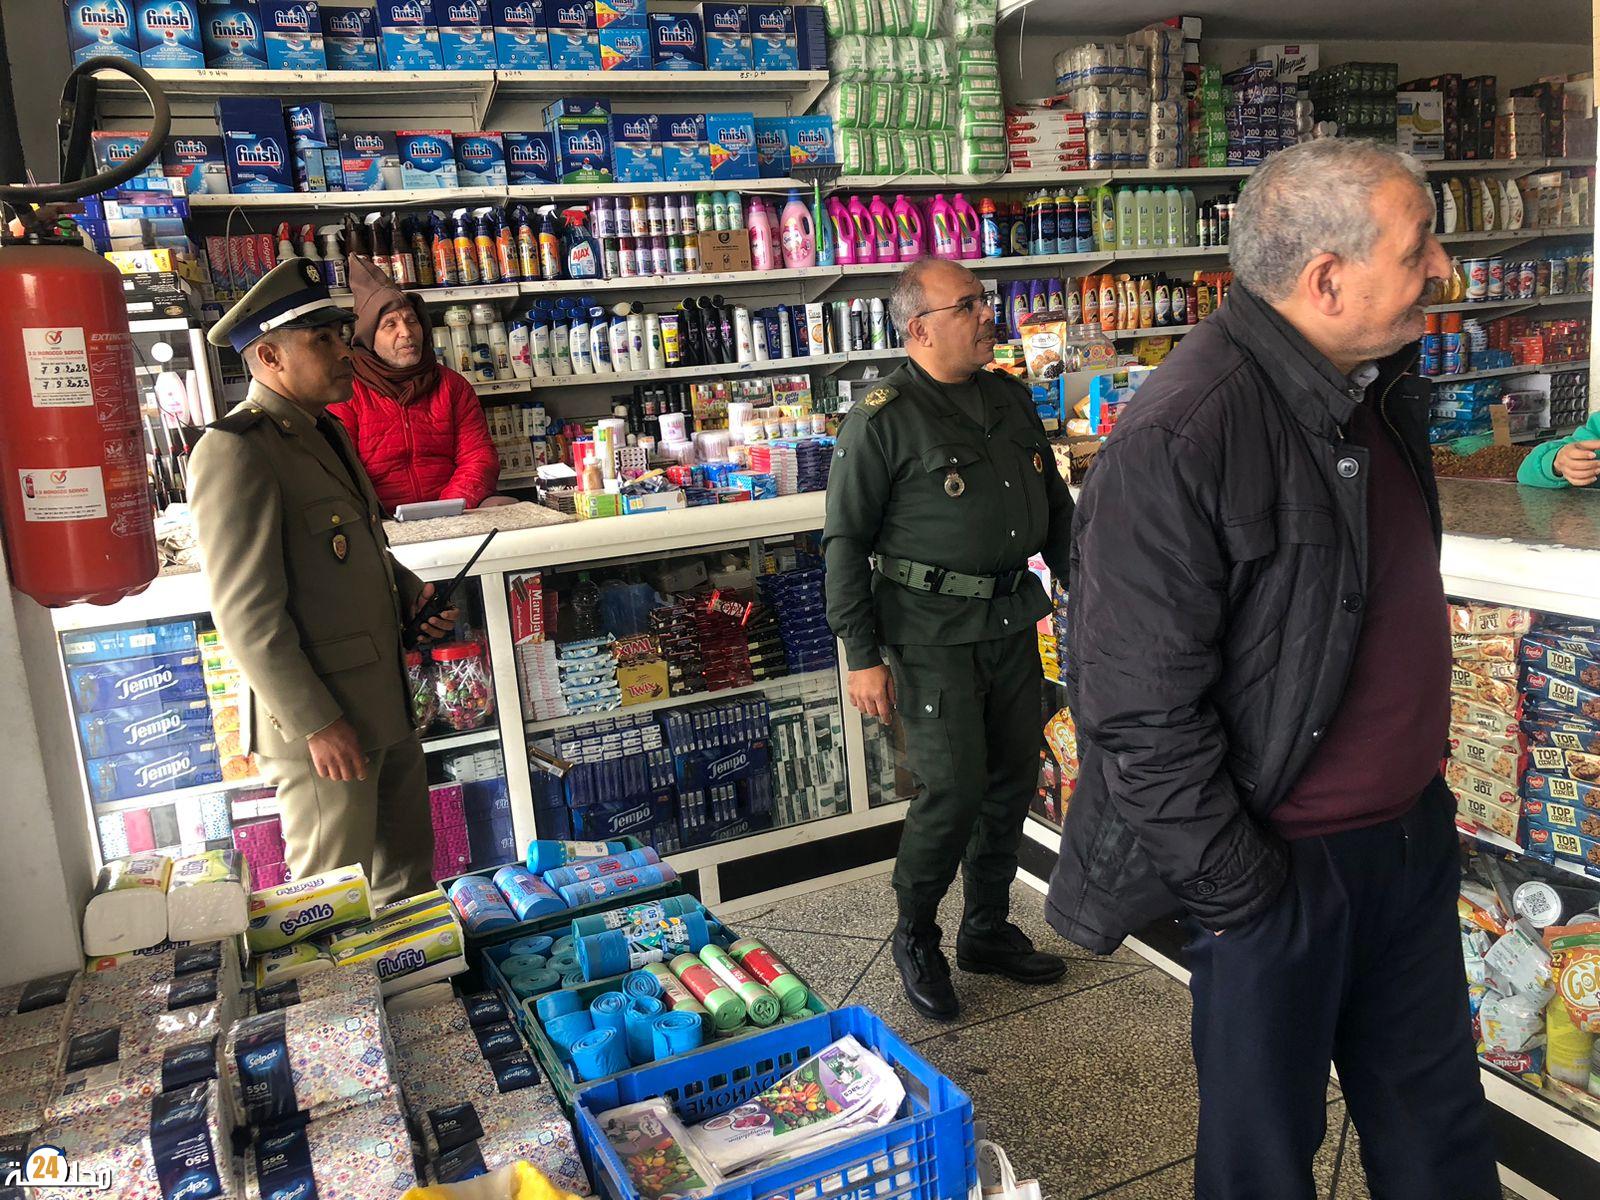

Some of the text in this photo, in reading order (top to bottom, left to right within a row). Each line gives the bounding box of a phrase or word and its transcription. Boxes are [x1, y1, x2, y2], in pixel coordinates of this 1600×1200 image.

[81, 5, 125, 24] finish
[145, 9, 189, 27] finish
[275, 10, 306, 25] finish
[392, 6, 423, 19] finish
[449, 6, 478, 20] finish
[505, 7, 533, 21] finish
[558, 9, 584, 23] finish
[331, 16, 360, 30] finish
[714, 14, 738, 27] finish
[760, 14, 784, 28] finish
[212, 20, 253, 37] finish
[659, 27, 693, 44] finish
[616, 37, 636, 48] finish
[1244, 107, 1256, 115] 200
[1264, 107, 1276, 115] 200
[290, 113, 313, 129] finish
[624, 123, 649, 136] finish
[672, 123, 696, 136] finish
[719, 129, 746, 142] finish
[799, 130, 824, 142] finish
[1246, 128, 1260, 136] 200
[1264, 129, 1277, 137] 200
[1282, 128, 1295, 136] 200
[355, 135, 384, 149] finish
[755, 131, 781, 143] finish
[1213, 132, 1225, 141] 300
[174, 141, 207, 155] finish
[410, 142, 441, 156] finish
[463, 143, 492, 157] finish
[569, 137, 600, 153] finish
[108, 144, 141, 160] finis
[237, 145, 280, 165] finish
[511, 147, 546, 163] finish
[1211, 153, 1224, 162] 300
[246, 237, 256, 270] Colgate
[262, 236, 272, 270] Colgate
[572, 247, 590, 261] AJAX
[41, 366, 48, 375] 7
[54, 366, 60, 374] 9
[65, 363, 88, 373] 2022
[43, 379, 90, 390] 7 9 2023
[531, 589, 543, 632] Maruja
[722, 601, 744, 616] KitKat
[617, 638, 655, 656] TWIX
[1565, 642, 1584, 651] TOP
[1552, 652, 1572, 665] TOP
[1550, 661, 1573, 672] COOKIES
[1452, 669, 1471, 681] TOP
[115, 666, 177, 700] Tempo
[1452, 679, 1472, 687] COOKIES
[1554, 682, 1575, 695] TOP
[1552, 692, 1574, 703] COOKIES
[1476, 712, 1498, 721] COOKIES
[124, 710, 186, 745] Tempo
[1555, 733, 1575, 744] TOP
[1466, 744, 1485, 757] TOP
[1537, 749, 1558, 761] TOP
[1467, 753, 1486, 763] COOKIES
[1538, 758, 1561, 767] COOKIES
[135, 753, 196, 788] Tempo
[707, 751, 750, 780] Tempo
[1473, 777, 1493, 788] COOKIES
[1552, 779, 1573, 791] TOP
[1473, 785, 1493, 797] TOP
[1553, 788, 1575, 797] COOKIES
[1468, 799, 1486, 811] TOP
[1550, 805, 1571, 817] TOP
[608, 804, 653, 833] Tempo
[1468, 808, 1487, 818] COOKIES
[1551, 814, 1574, 824] COOKIES
[714, 821, 749, 840] Tempo
[1556, 834, 1577, 846] TOP
[1556, 843, 1578, 853] COOKIES
[280, 903, 335, 936] فلافي
[648, 909, 658, 920] 50
[474, 1003, 500, 1016] Selpak
[486, 1036, 512, 1048] Selpak
[172, 1049, 209, 1065] Selpak
[247, 1048, 278, 1069] Selpak
[1492, 1058, 1528, 1072] Leader
[503, 1067, 530, 1081] Selpak
[843, 1084, 861, 1097] sacs
[160, 1108, 199, 1126] Selpak
[266, 1131, 297, 1149] Selpak
[174, 1177, 209, 1200] Selpak
[276, 1183, 306, 1200] Selpak
